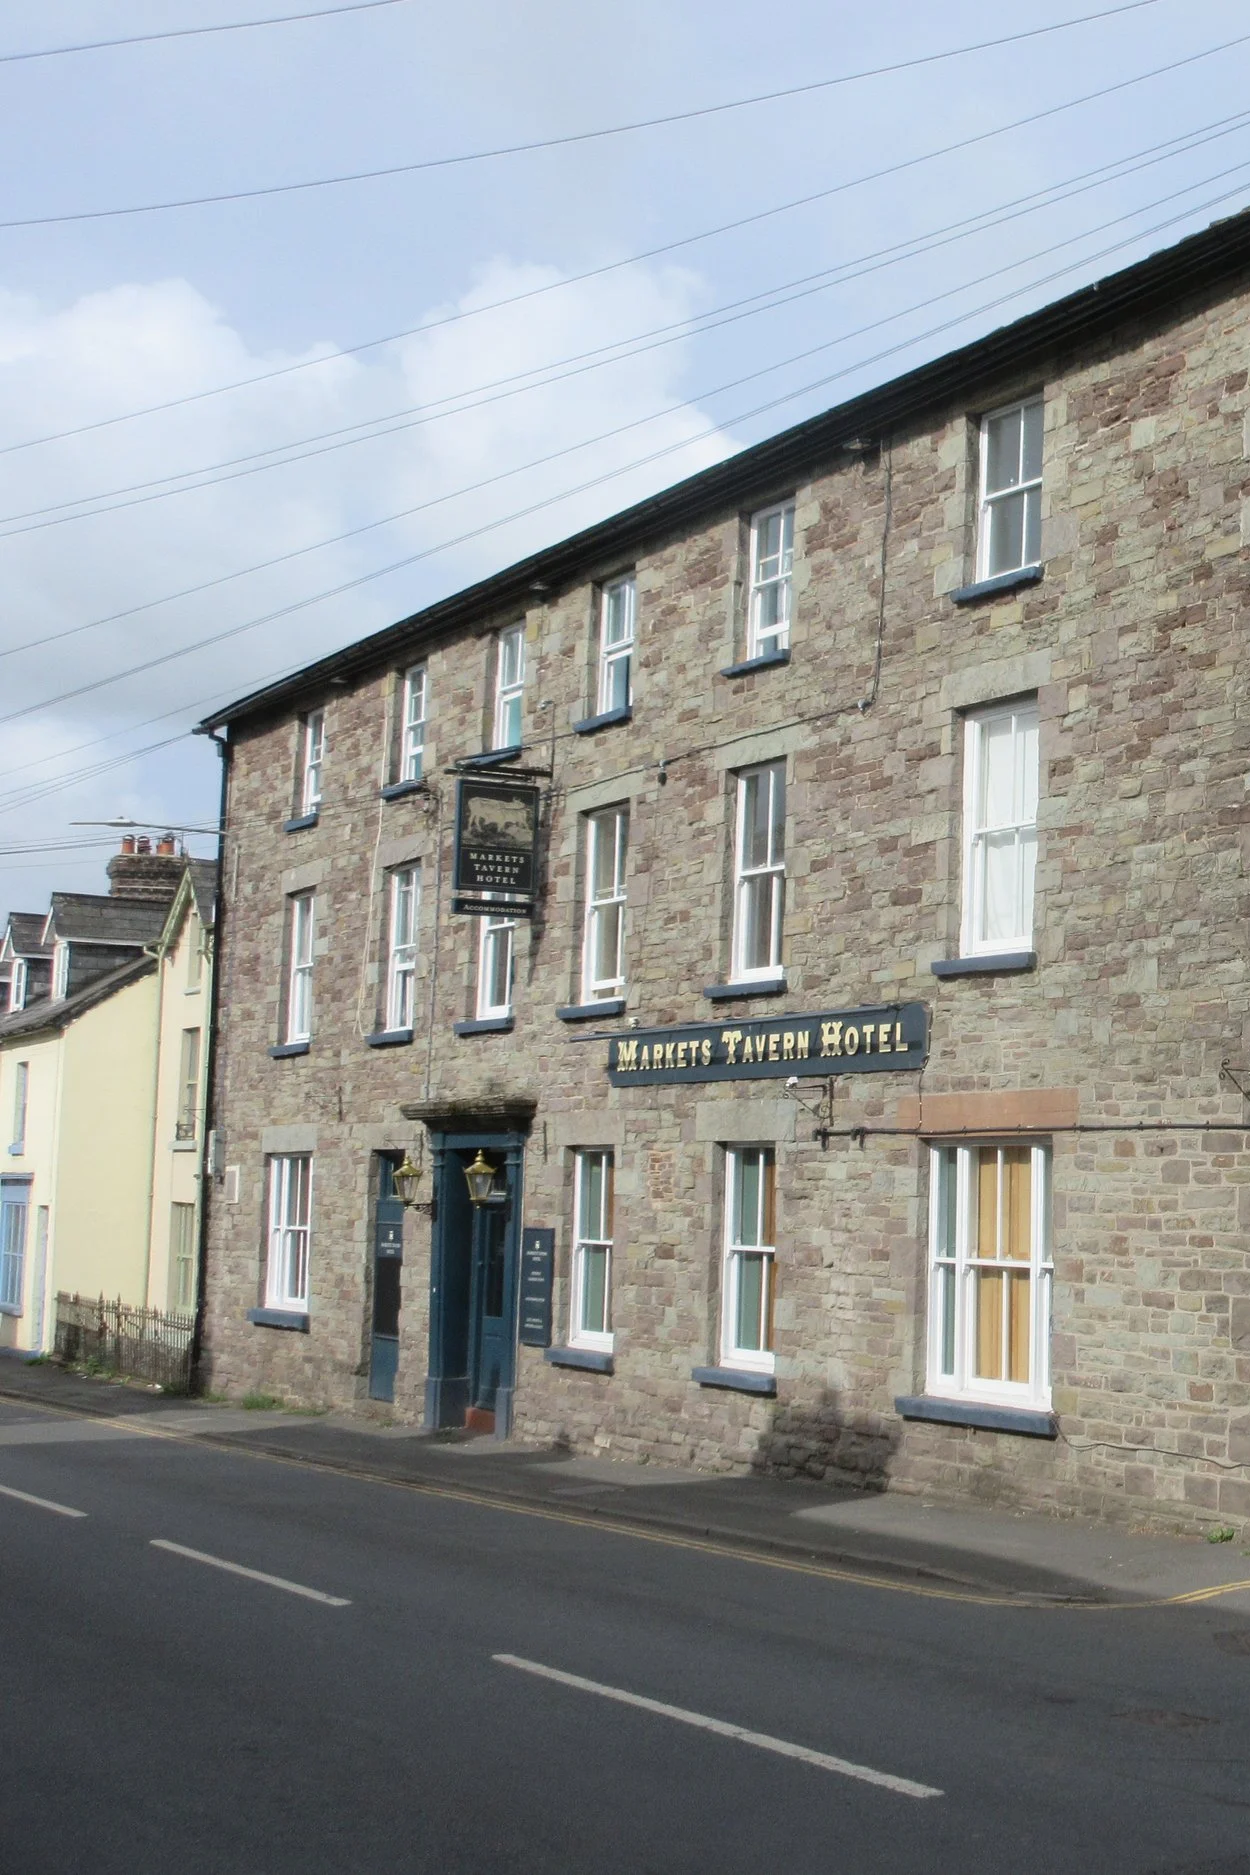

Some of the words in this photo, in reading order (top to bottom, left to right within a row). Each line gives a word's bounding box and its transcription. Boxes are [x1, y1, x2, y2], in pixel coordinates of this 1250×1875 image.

[469, 853, 525, 864] MARKETS
[474, 864, 520, 874] TAVERN
[476, 874, 516, 885] HOTEL
[616, 1039, 711, 1072] MARKETS
[721, 1030, 810, 1065] TAVERN
[820, 1020, 909, 1057] HOTEL
